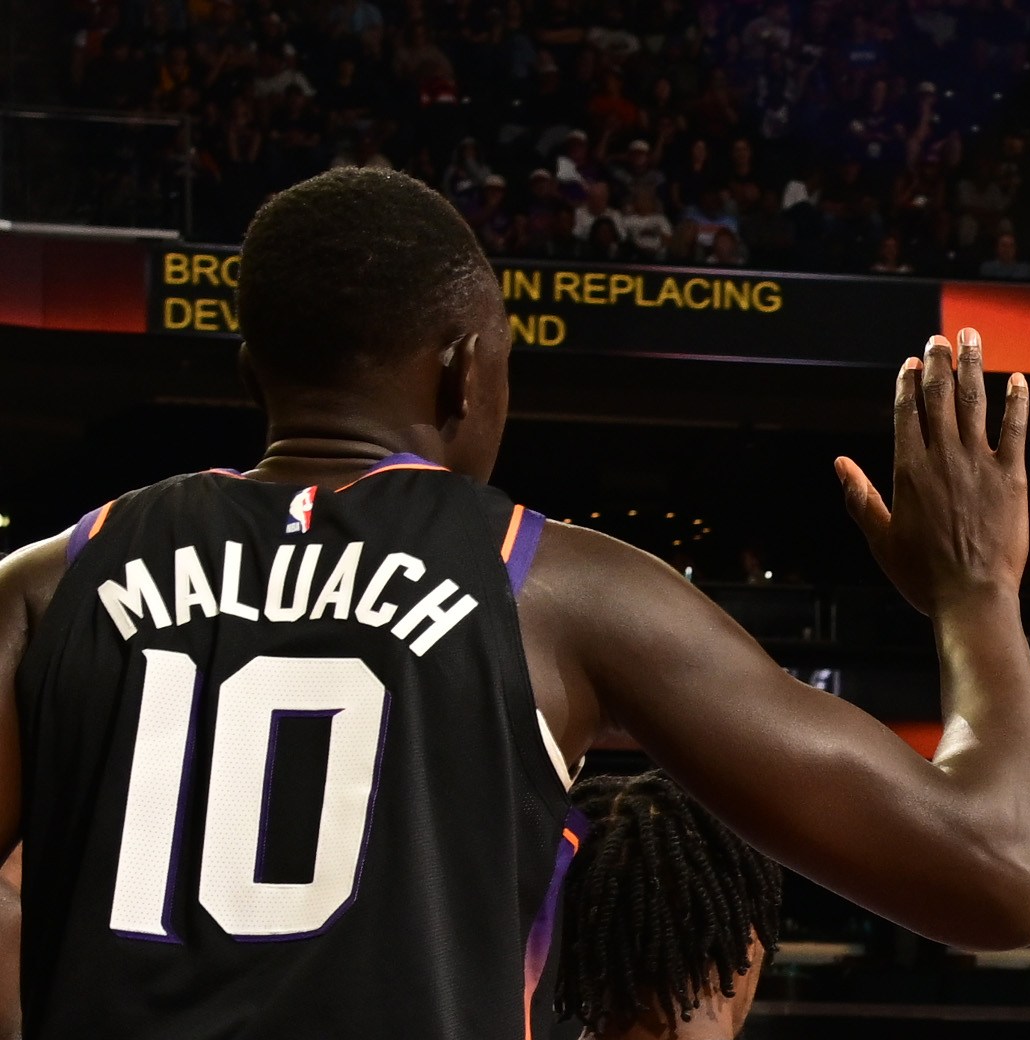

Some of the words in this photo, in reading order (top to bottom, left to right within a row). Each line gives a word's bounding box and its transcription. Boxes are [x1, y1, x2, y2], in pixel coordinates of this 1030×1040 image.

[501, 268, 543, 302] IN
[553, 270, 784, 313] REPLACING
[97, 541, 478, 656] MALUACH
[109, 648, 392, 940] 10
